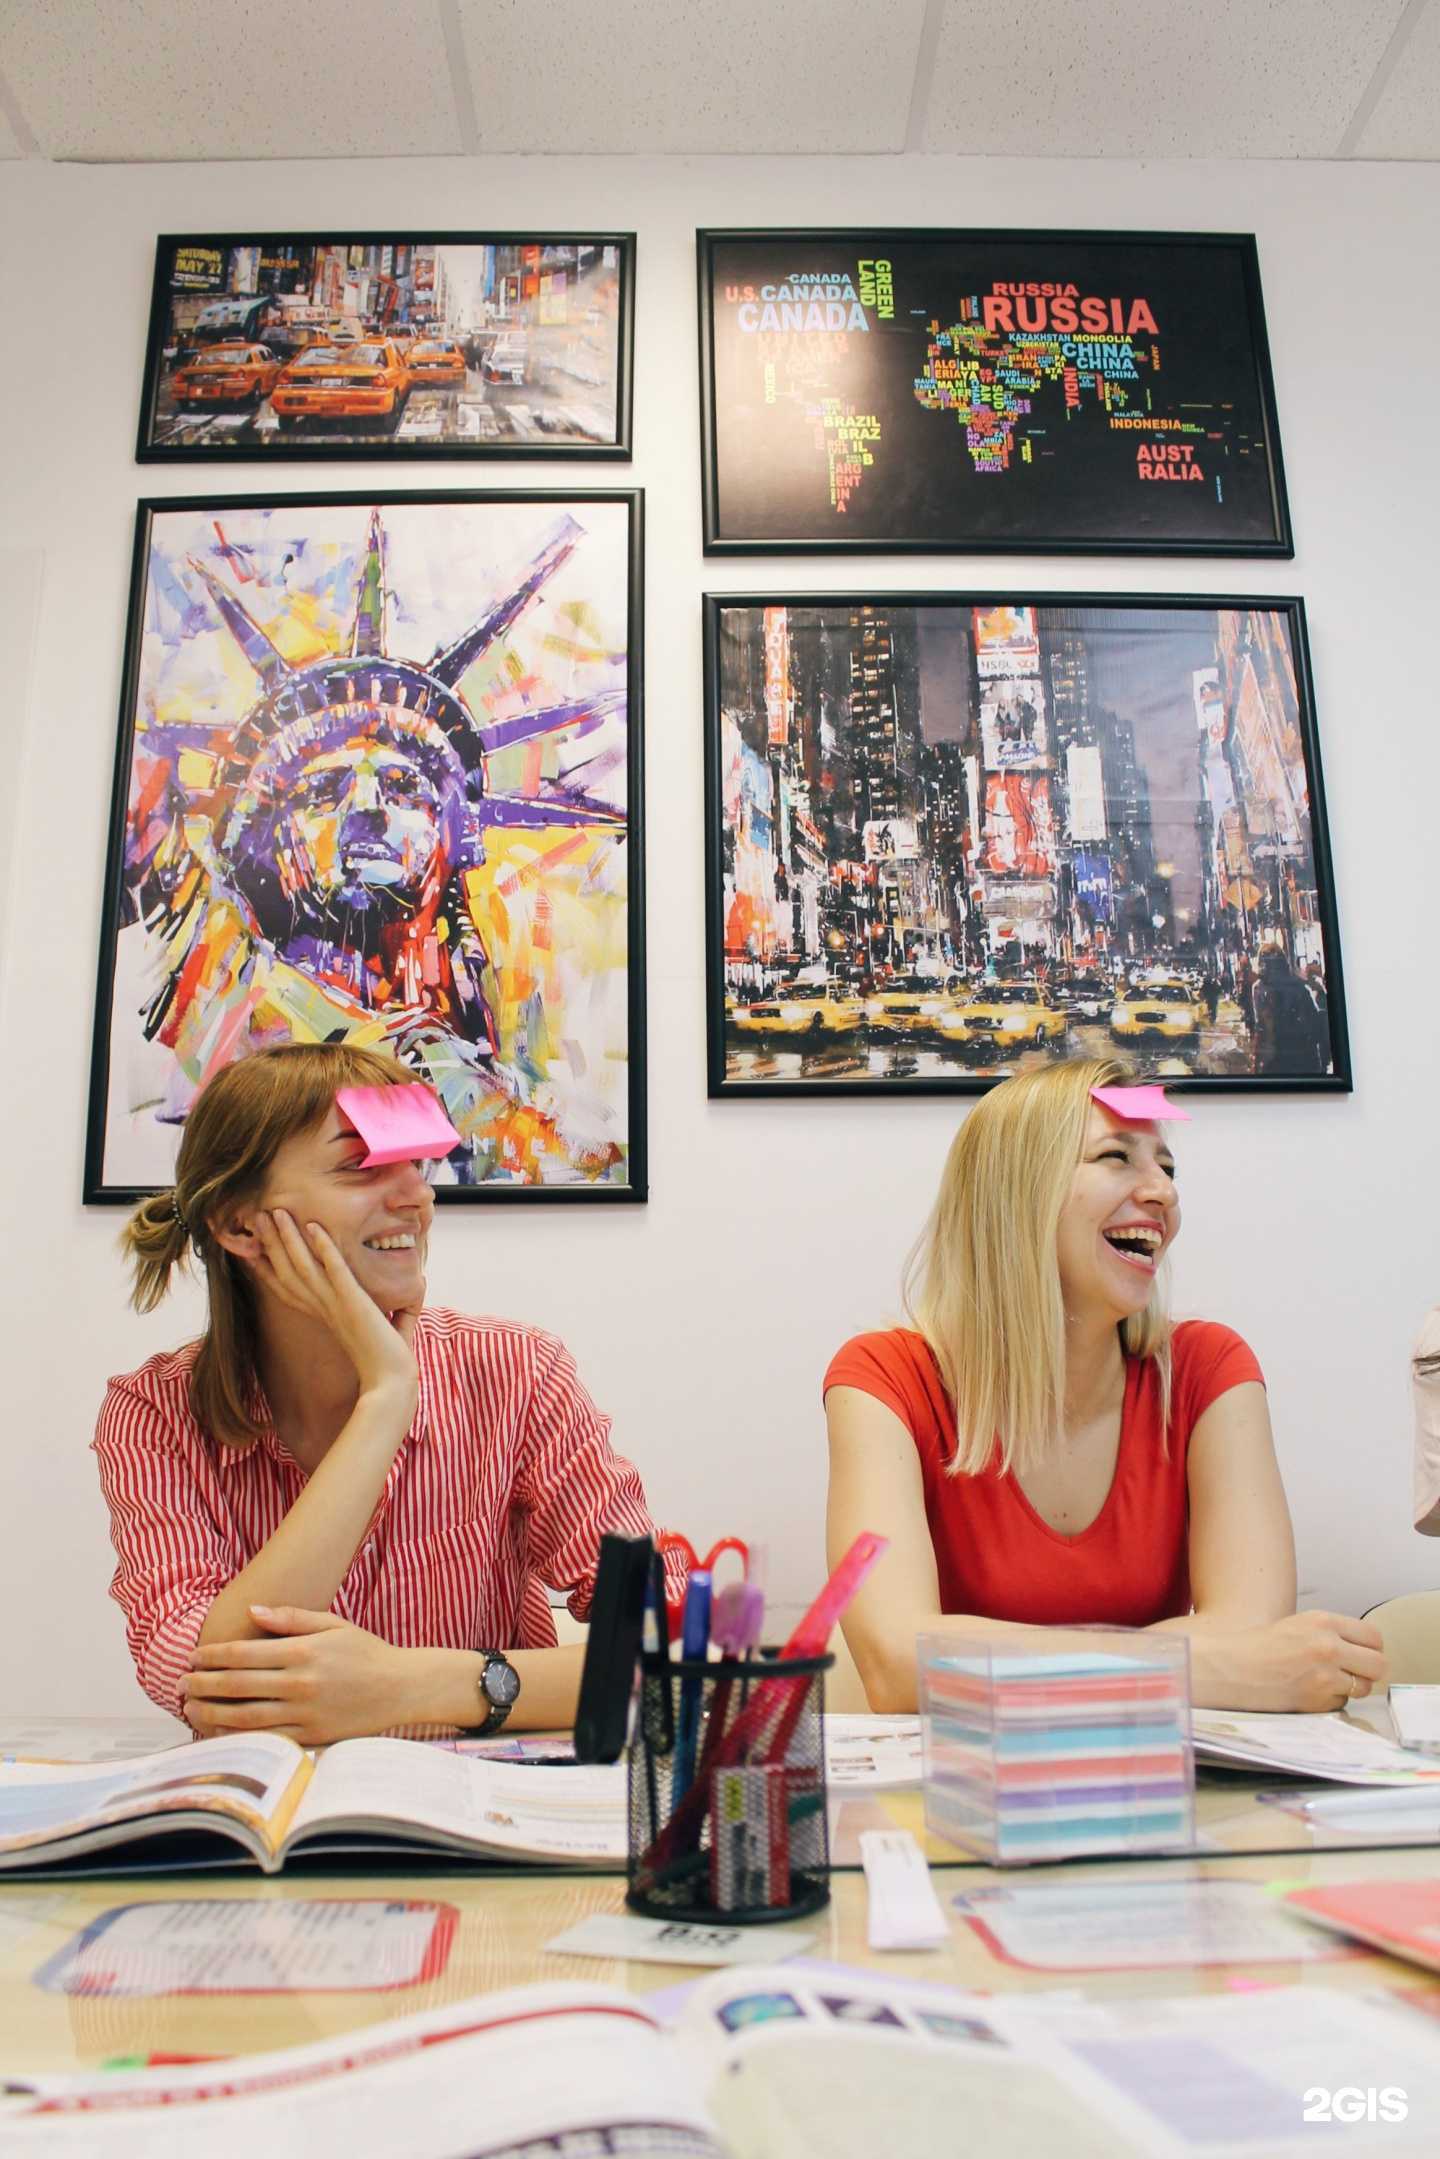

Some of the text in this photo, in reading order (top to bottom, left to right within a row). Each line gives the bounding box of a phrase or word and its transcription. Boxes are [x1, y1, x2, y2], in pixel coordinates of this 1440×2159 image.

[175, 260, 205, 273] MAY
[789, 273, 852, 284] CANADA
[858, 260, 876, 307] LAND
[725, 285, 860, 302] U.S. CANADA
[875, 259, 894, 319] GREEN
[992, 282, 1080, 297] RUSSIA
[738, 303, 870, 333] CANADA
[983, 296, 1160, 334] RUSSIA
[1008, 333, 1133, 344] KAZAKHSTAN MONGOLIA
[1062, 342, 1136, 358] CHINA
[935, 359, 956, 369] ALG
[960, 360, 979, 370] LIB
[1077, 357, 1135, 370] CHINA
[935, 368, 960, 379] ERIA
[995, 369, 1020, 378] SAUDI
[1104, 370, 1139, 379] CHINA
[981, 384, 993, 402] AN
[1063, 366, 1080, 408] INDIA
[992, 384, 1005, 410] SUD
[824, 415, 881, 428] BRAZIL
[1109, 417, 1182, 430] INDONESIA
[838, 428, 881, 441] BRAZ
[1136, 444, 1194, 462] AUST
[1139, 463, 1204, 480] RALIA
